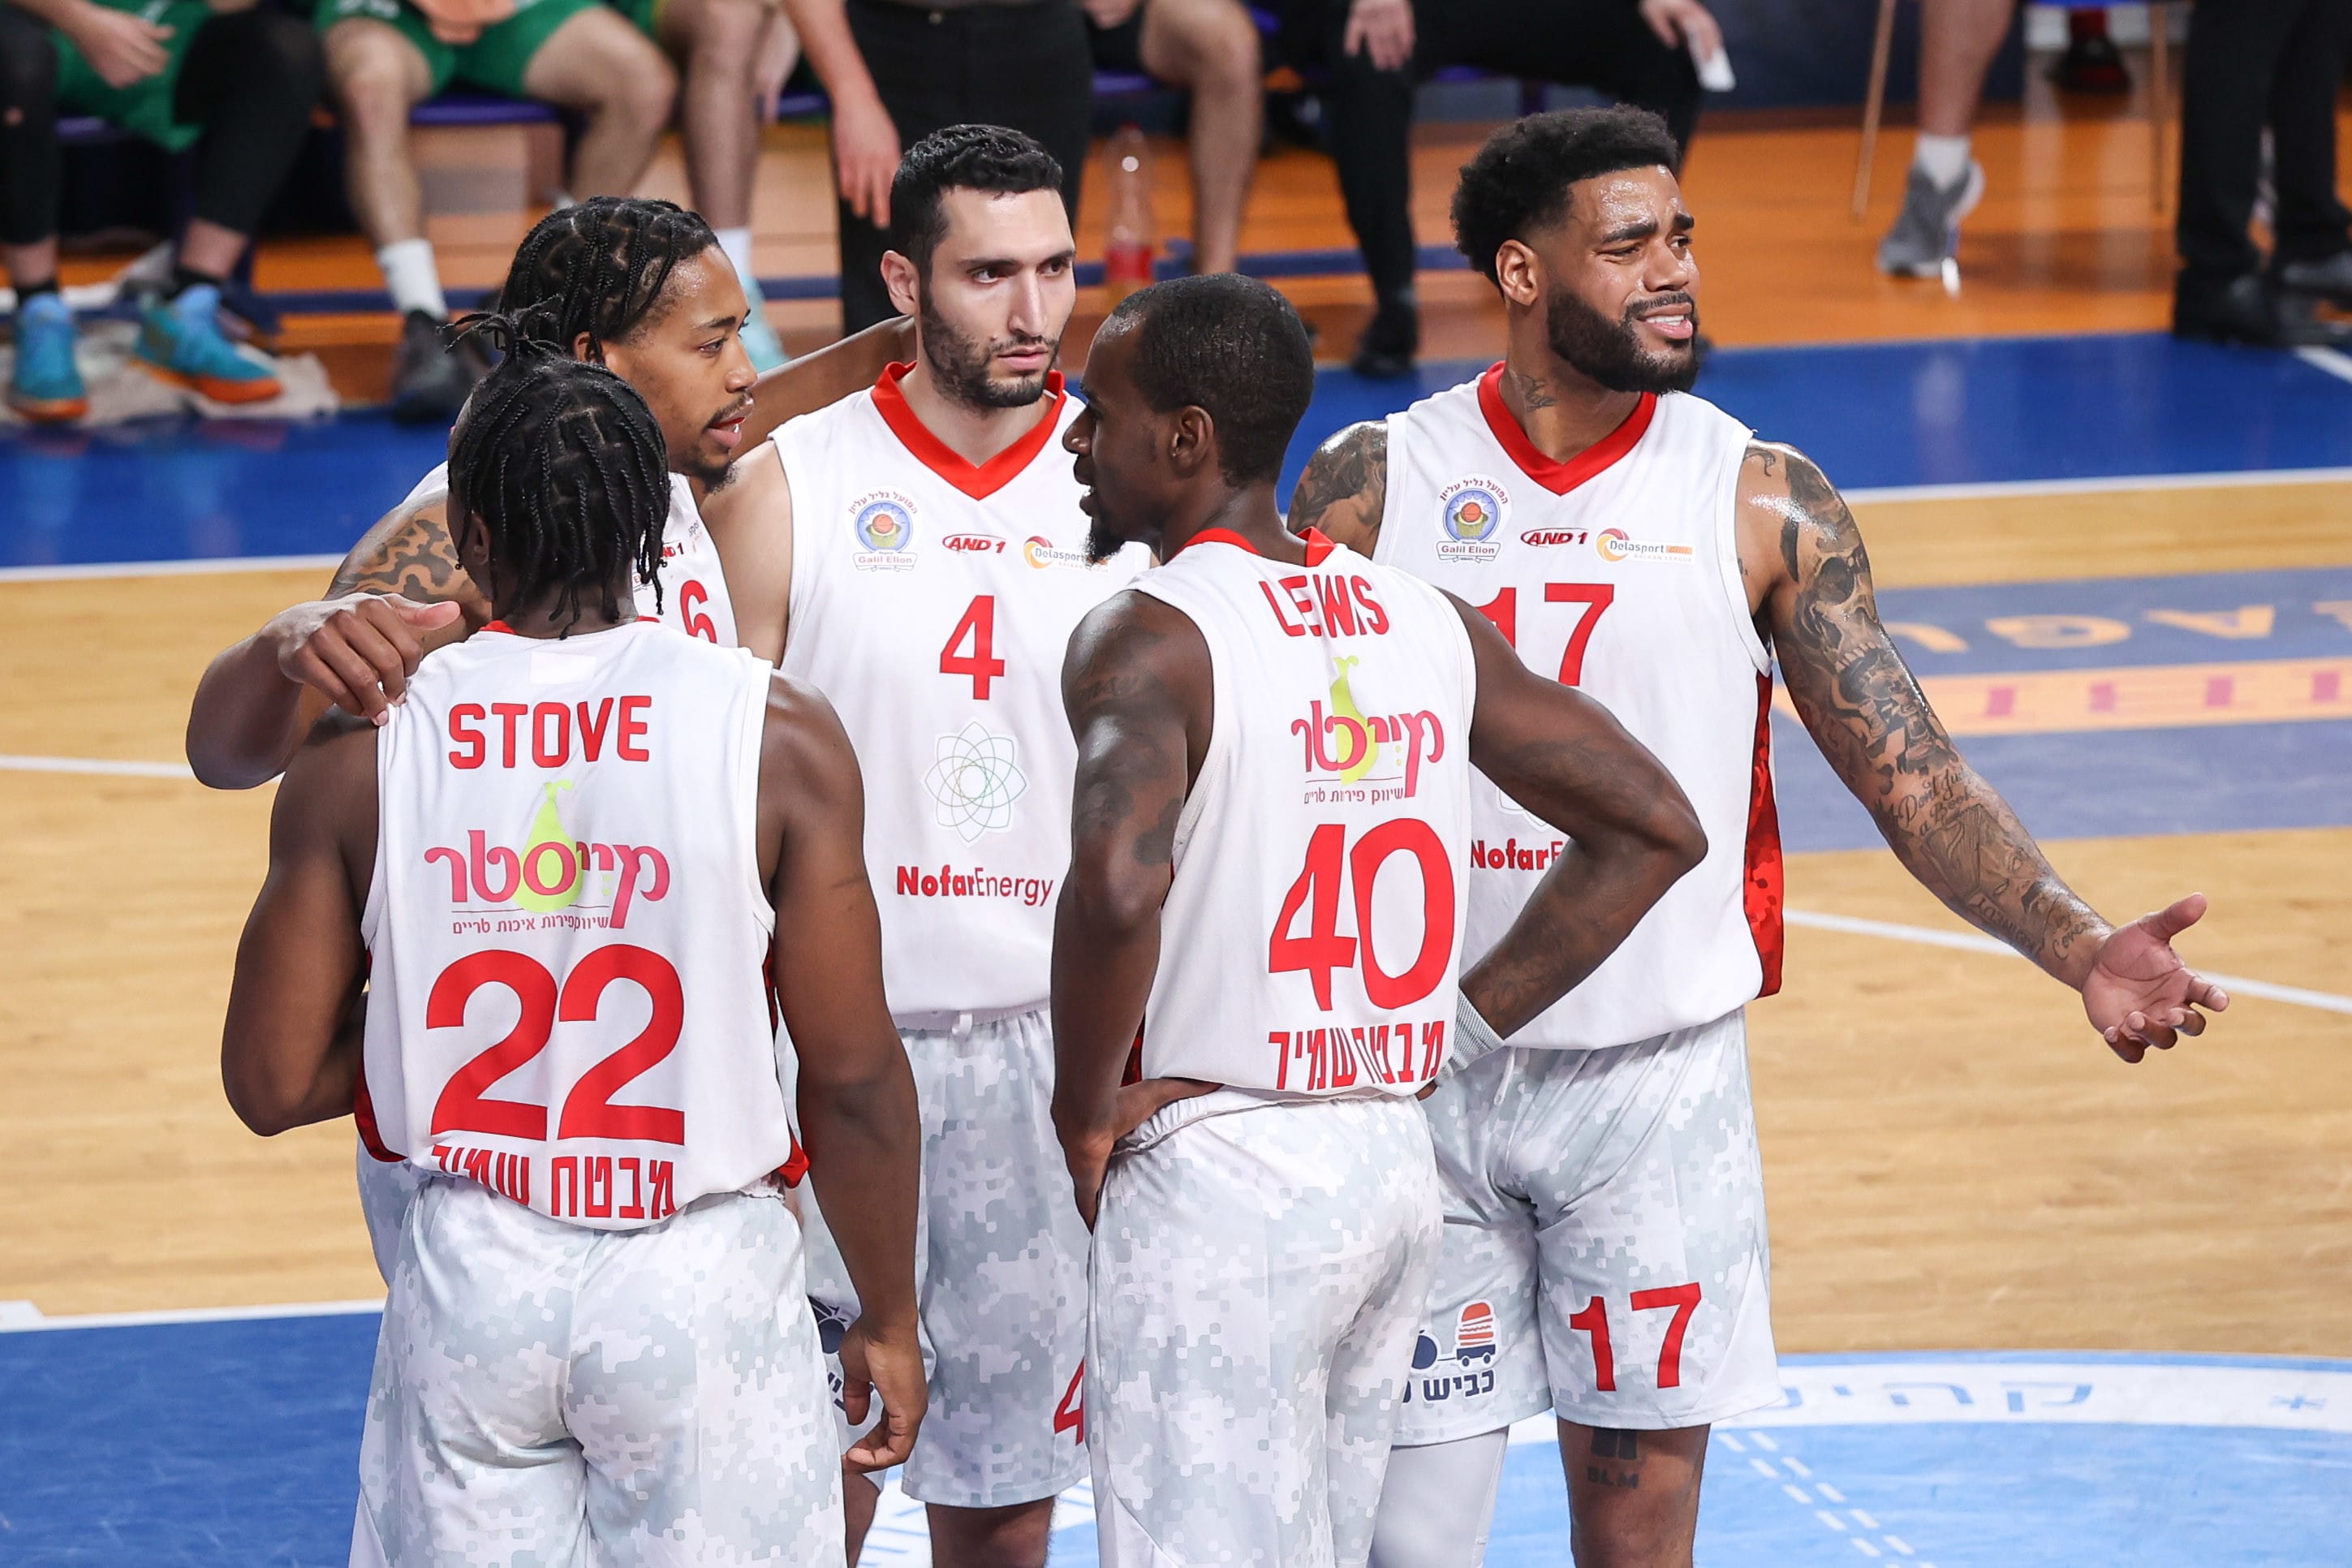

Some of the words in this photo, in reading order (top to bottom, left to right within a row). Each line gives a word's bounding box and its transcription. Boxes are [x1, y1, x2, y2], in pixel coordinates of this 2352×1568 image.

[1440, 483, 1461, 502] עליון
[1463, 478, 1484, 487] גליל
[1486, 480, 1508, 504] הפועל
[848, 497, 868, 515] עליון
[868, 490, 890, 500] גליל
[893, 491, 918, 515] הפועל
[948, 536, 991, 552] AND
[994, 540, 1006, 554] 1
[1441, 545, 1466, 554] Galil
[1468, 545, 1495, 554] Elion
[1527, 532, 1574, 546] AND
[1577, 532, 1588, 545] 1
[1609, 540, 1665, 554] Delasport
[858, 555, 883, 563] Galil
[886, 555, 913, 564] Elion
[1035, 547, 1084, 562] Delasport
[680, 579, 717, 644] 6
[940, 594, 1006, 700] 4
[1474, 583, 1615, 687] 17
[448, 696, 653, 769] STOVE
[1371, 787, 1404, 805] שיווק
[424, 829, 670, 929] מייסטר
[896, 864, 1053, 907] NofarEnergy
[453, 918, 491, 934] טריים
[497, 918, 536, 933] איכות
[1269, 818, 1455, 1011] 40
[426, 944, 685, 1146] 22
[551, 1156, 678, 1220] מבטח
[1570, 1282, 1702, 1392] 17
[1423, 1369, 1495, 1402] כביש
[1054, 1356, 1086, 1446] 4
